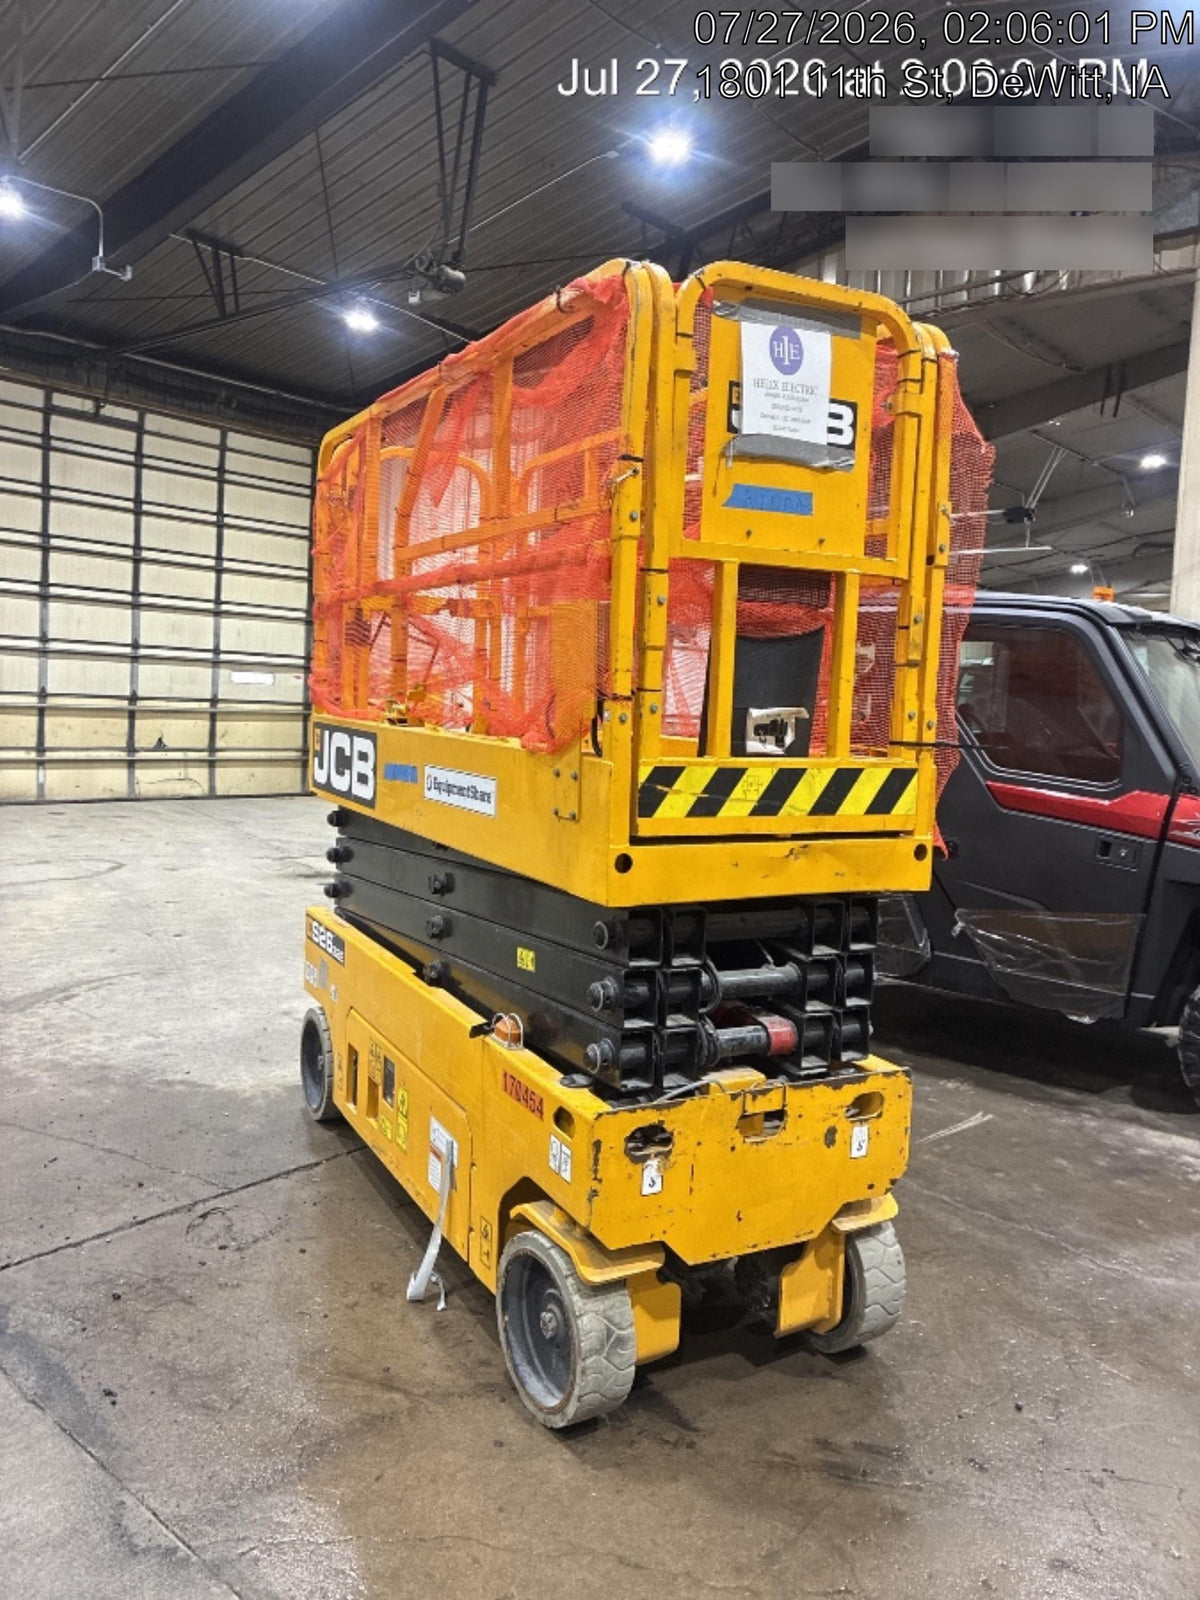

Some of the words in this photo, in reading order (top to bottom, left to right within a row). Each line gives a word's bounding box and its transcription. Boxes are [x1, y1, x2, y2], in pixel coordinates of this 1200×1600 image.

[314, 729, 376, 801] JCB
[433, 776, 492, 805] EquipmentShare
[503, 1071, 544, 1121] 170454
